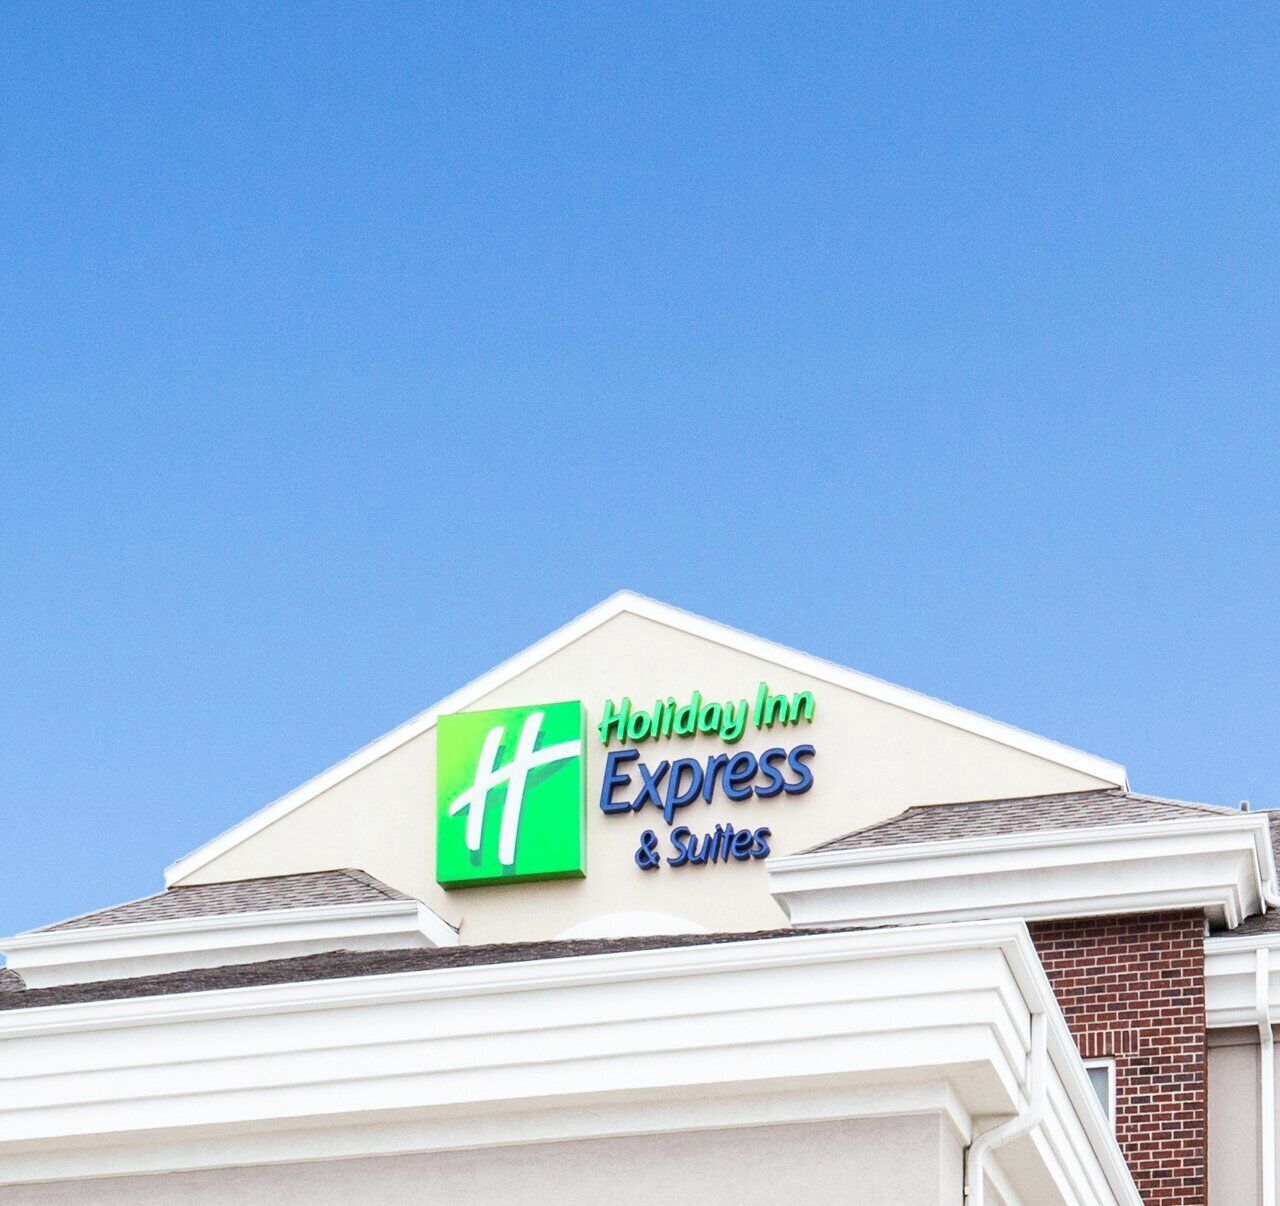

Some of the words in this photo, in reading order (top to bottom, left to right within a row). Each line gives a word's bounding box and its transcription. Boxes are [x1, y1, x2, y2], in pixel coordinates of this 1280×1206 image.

[599, 690, 748, 748] Holiday
[753, 682, 816, 729] Inn
[448, 711, 581, 866] H
[599, 744, 816, 825] Express
[634, 830, 660, 870] &
[667, 823, 771, 868] Suites
